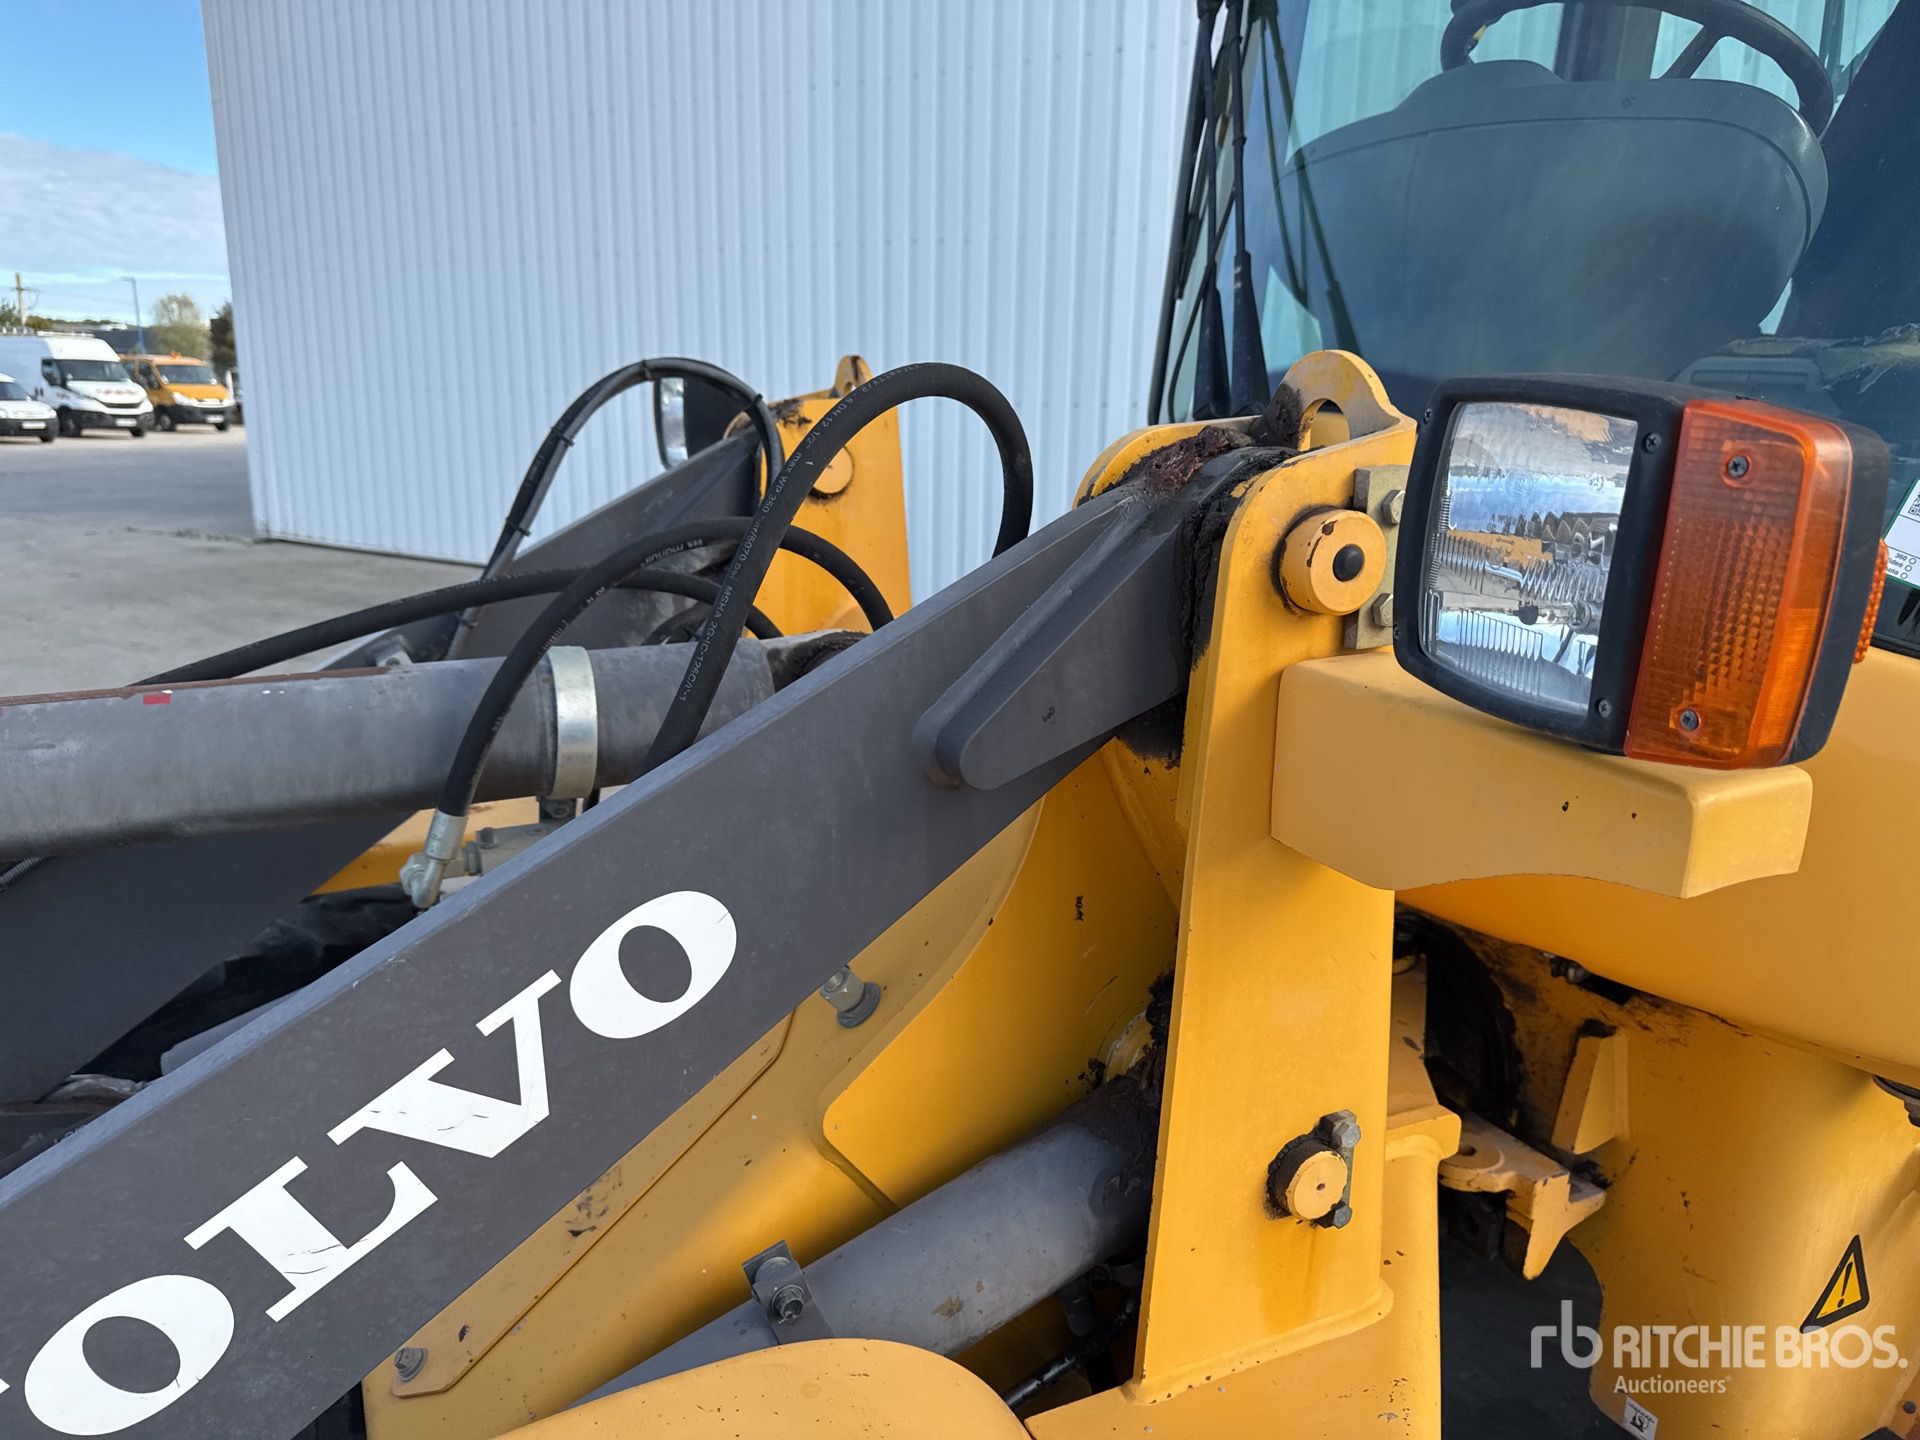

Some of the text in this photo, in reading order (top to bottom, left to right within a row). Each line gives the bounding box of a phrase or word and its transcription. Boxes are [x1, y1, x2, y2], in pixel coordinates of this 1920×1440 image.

[831, 402, 848, 417] DN
[820, 415, 834, 429] 12
[785, 451, 802, 475] max
[773, 474, 789, 494] WP
[762, 492, 777, 514] 350
[714, 584, 734, 620] MSHA
[0, 891, 737, 1436] OLVO
